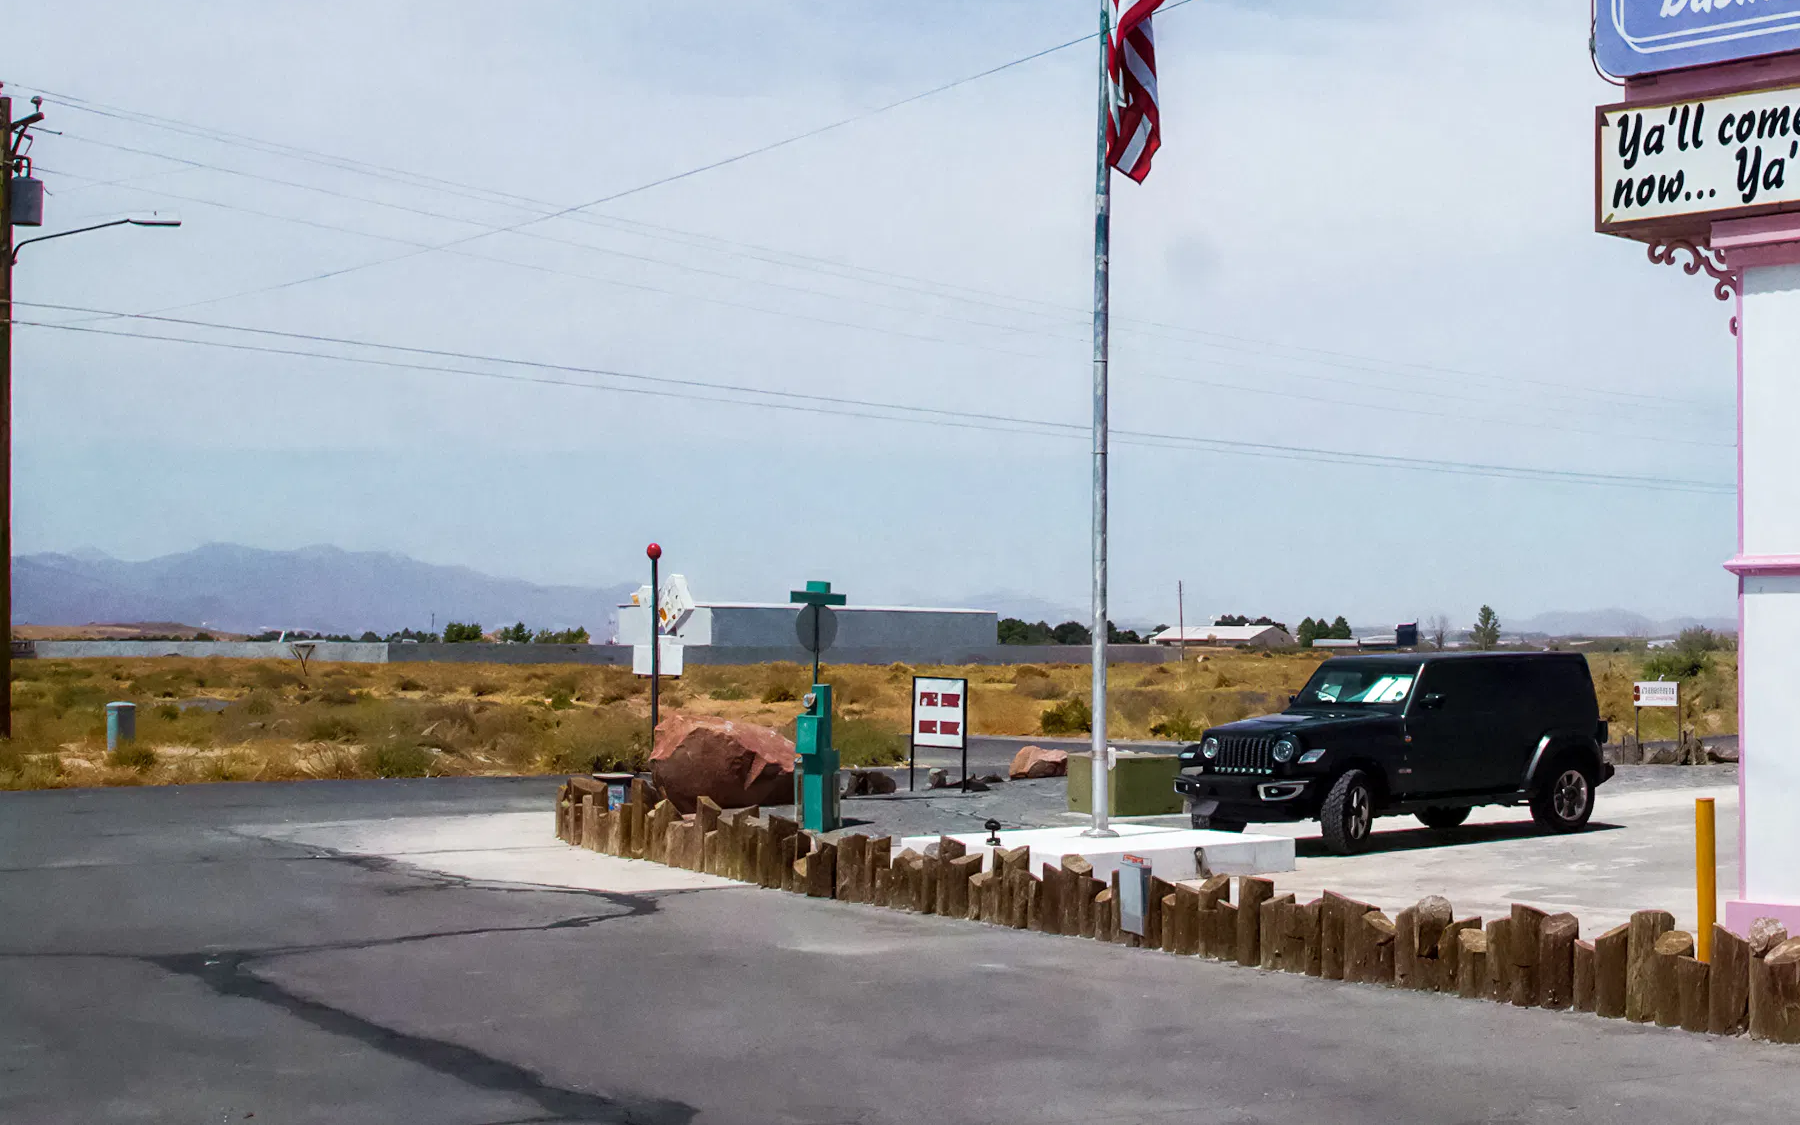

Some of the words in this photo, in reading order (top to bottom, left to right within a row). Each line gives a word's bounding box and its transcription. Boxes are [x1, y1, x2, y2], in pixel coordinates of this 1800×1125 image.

[1617, 102, 1705, 170] Ya'll
[1612, 169, 1717, 209] now...
[1735, 140, 1798, 204] Ya'
